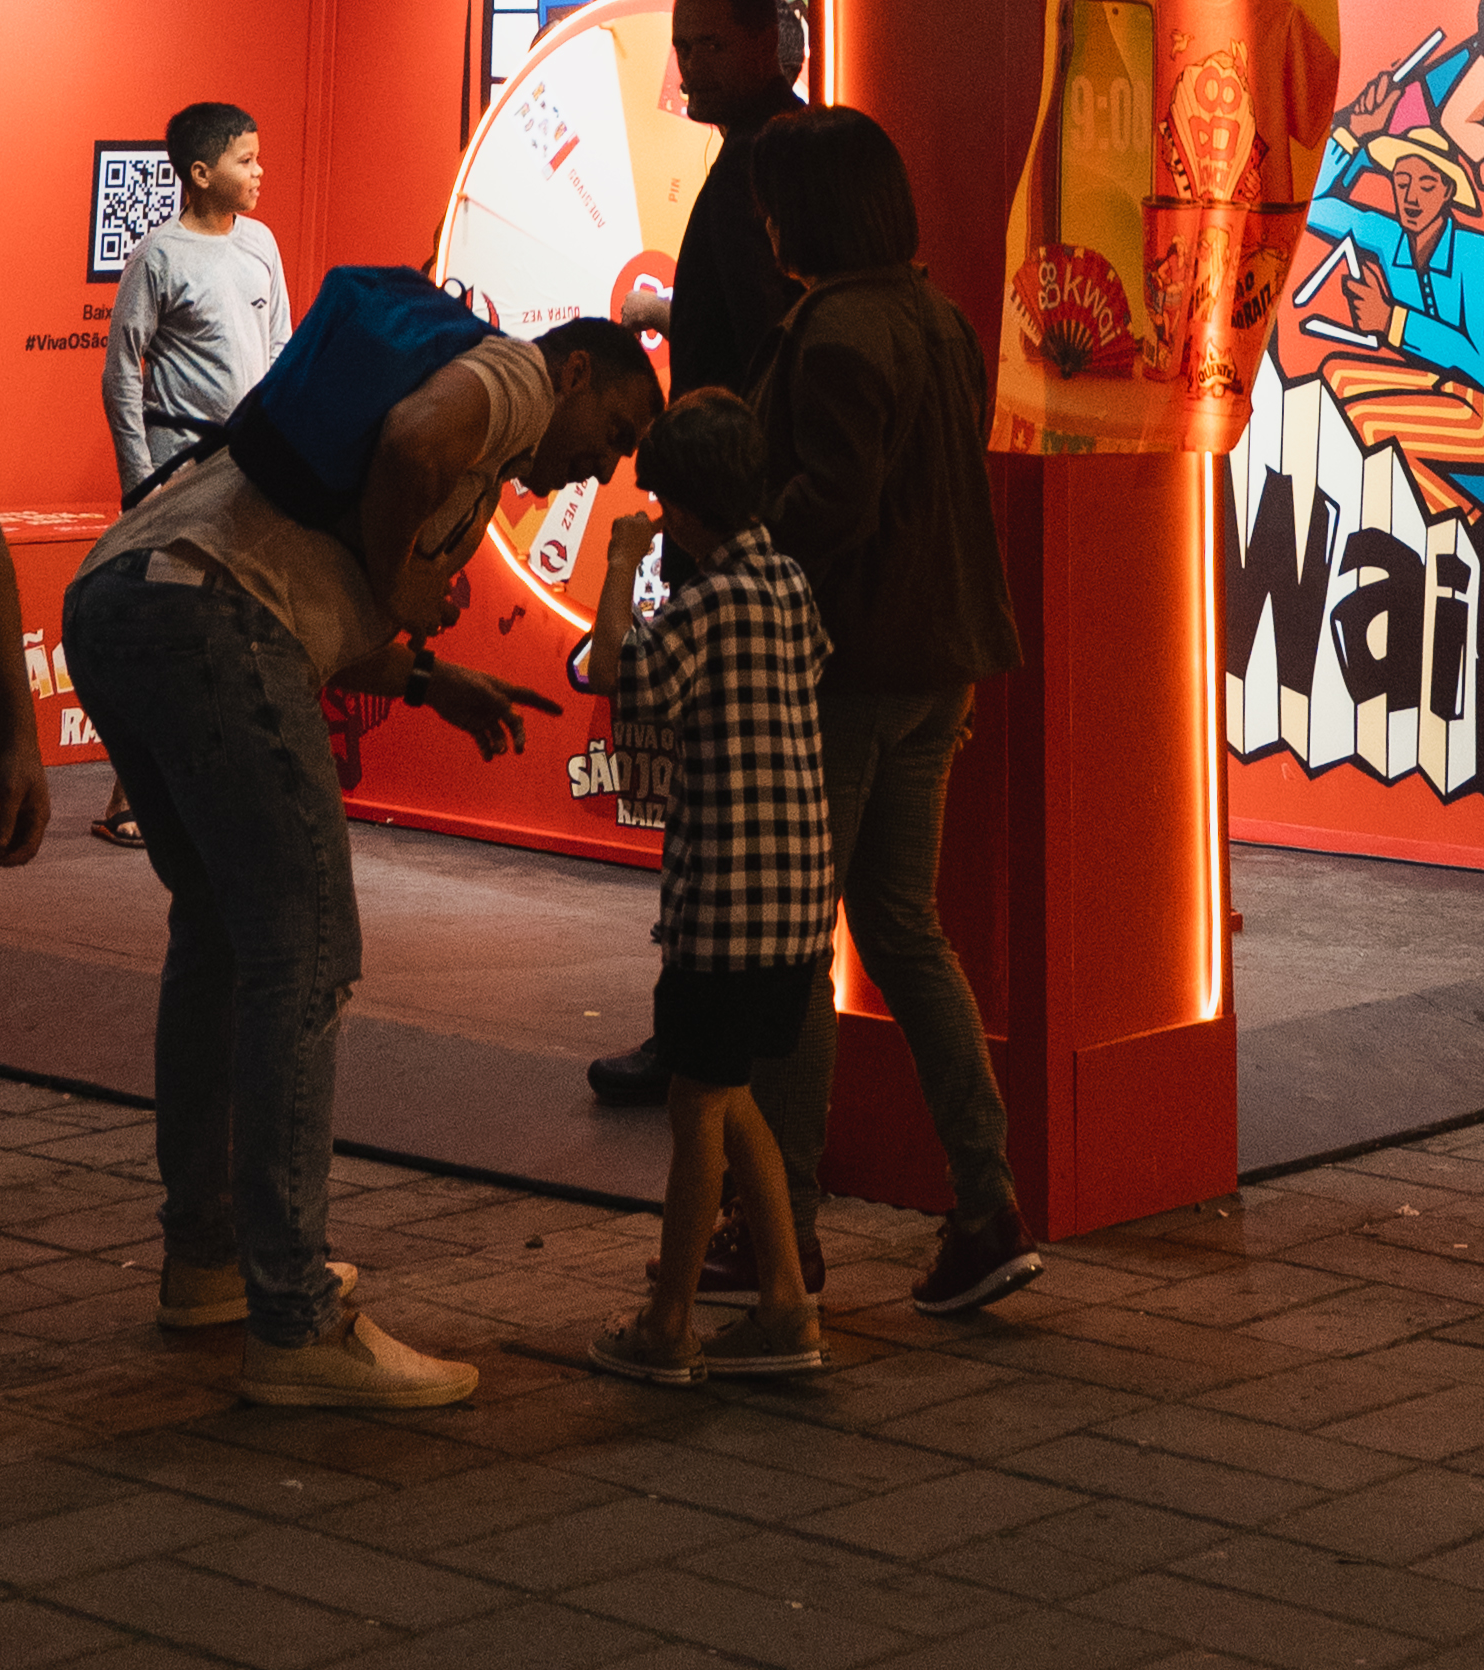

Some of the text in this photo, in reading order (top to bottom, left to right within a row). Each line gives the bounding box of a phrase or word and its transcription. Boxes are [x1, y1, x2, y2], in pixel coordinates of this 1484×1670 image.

[568, 168, 606, 229] ADESIVOS
[668, 177, 681, 204] PIN
[83, 303, 113, 320] Baix
[522, 309, 543, 324] VEZ
[1062, 263, 1122, 348] kwai
[25, 332, 108, 351] #VivaOSão
[568, 739, 633, 799] SÃO
[618, 798, 666, 830] RAIZ
